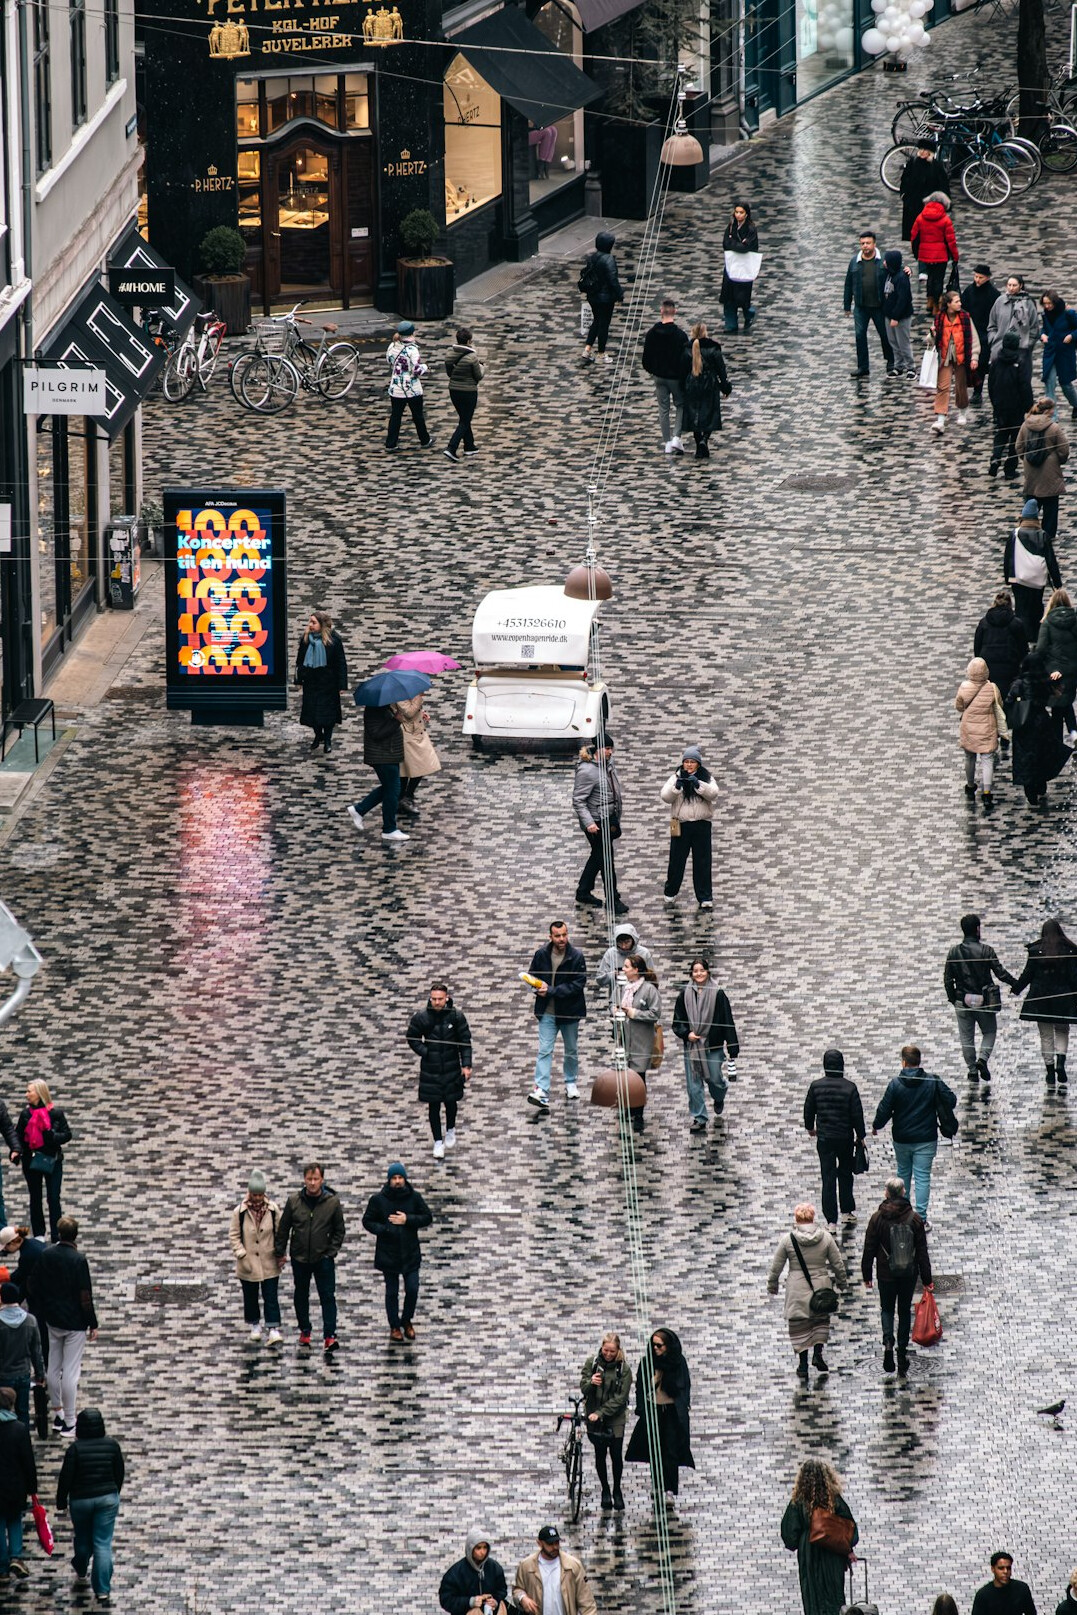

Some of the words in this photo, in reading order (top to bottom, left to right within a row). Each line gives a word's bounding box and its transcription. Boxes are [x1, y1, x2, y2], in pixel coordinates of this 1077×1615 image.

[261, 34, 353, 54] JUVELERER
[395, 160, 425, 176] HERTZ
[203, 176, 232, 192] HERTZ
[31, 381, 98, 393] PILGRIM
[177, 535, 271, 550] Koncerter
[177, 554, 197, 569] til
[199, 557, 222, 570] en
[225, 555, 272, 570] hund
[491, 634, 568, 643] www.copenhagenride.dk
